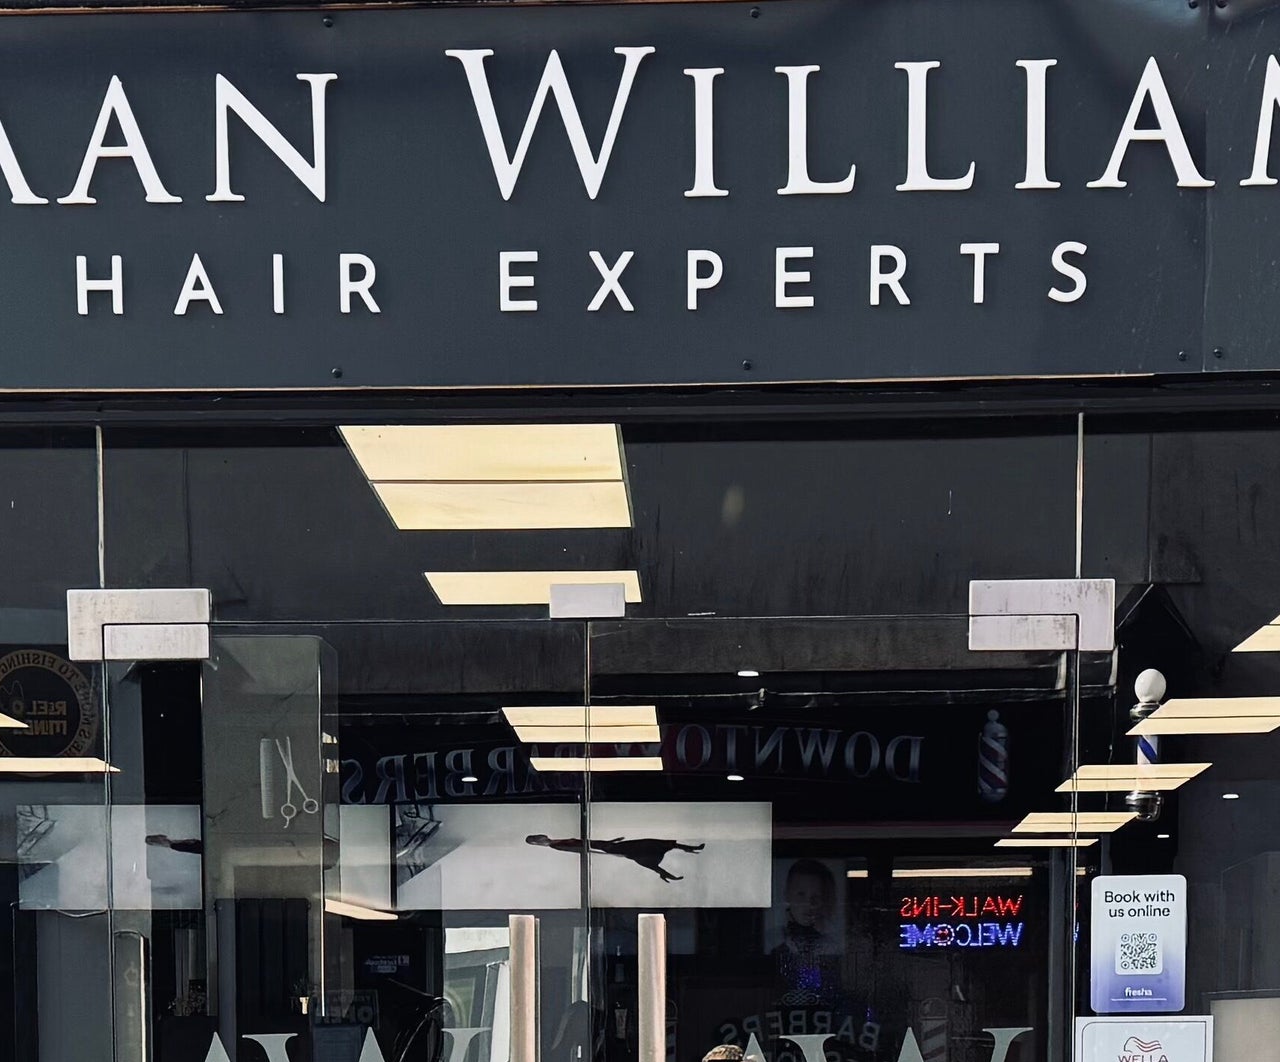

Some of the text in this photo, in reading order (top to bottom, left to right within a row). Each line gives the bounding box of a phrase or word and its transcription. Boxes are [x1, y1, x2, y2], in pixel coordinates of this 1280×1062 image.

[75, 241, 1089, 315] HAIR EXPERTS
[1104, 890, 1175, 903] Book with
[1108, 905, 1171, 918] us online
